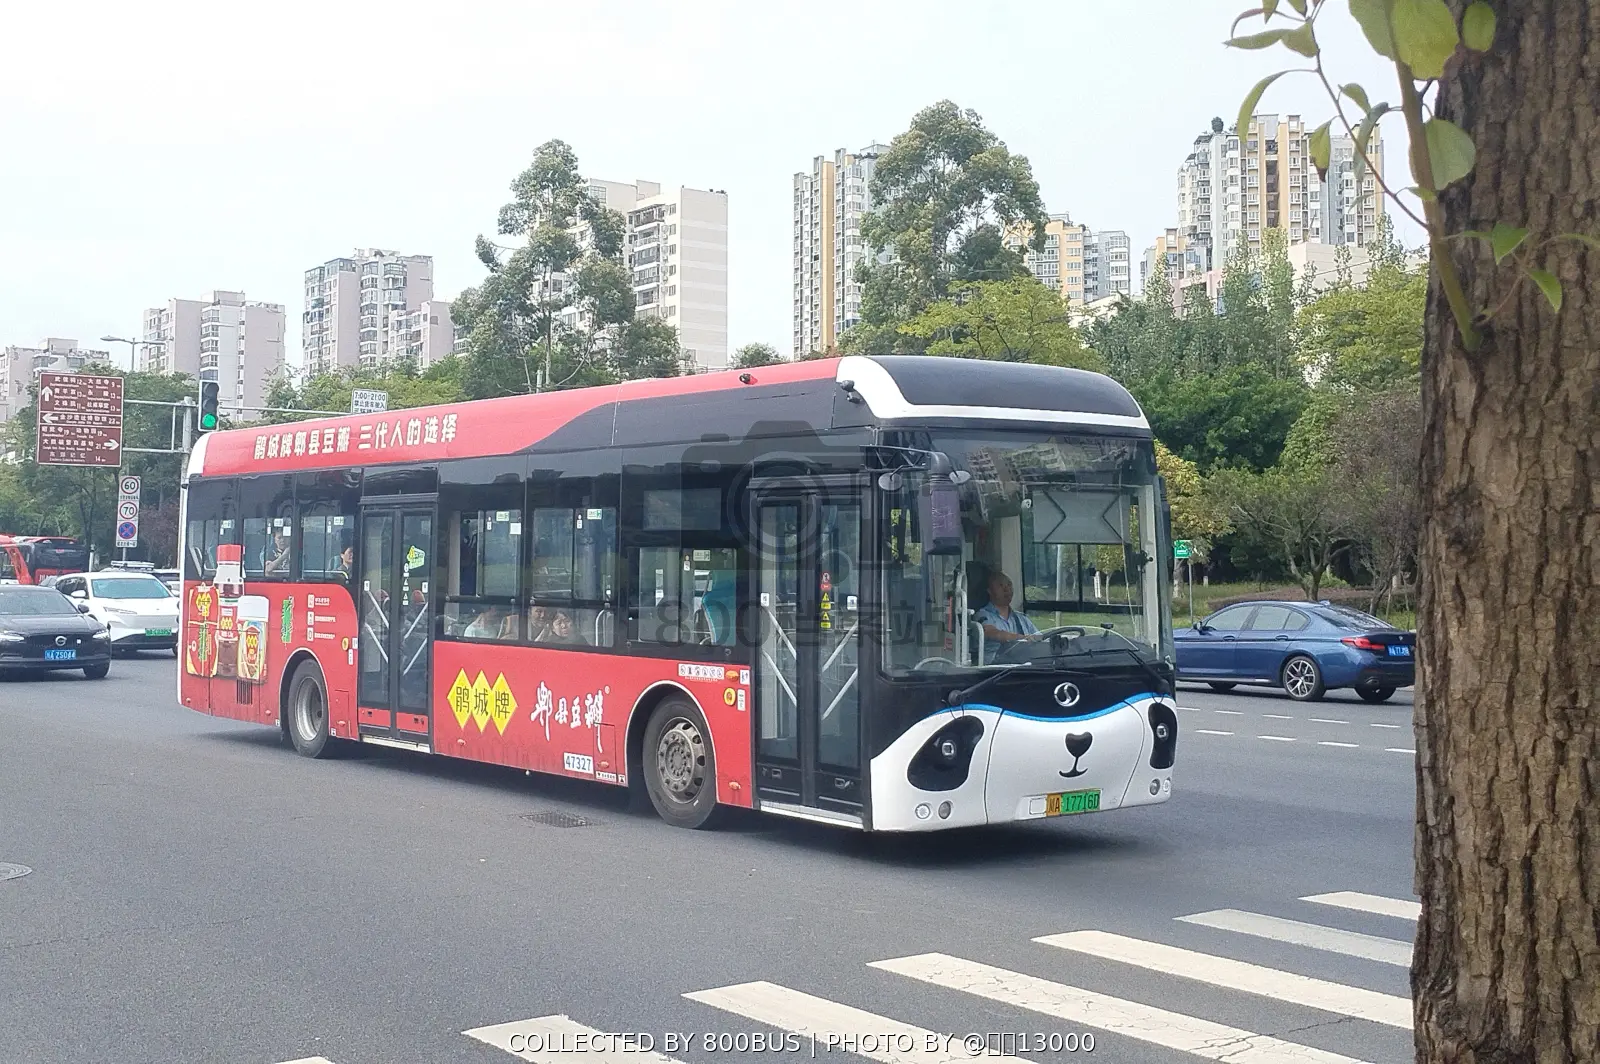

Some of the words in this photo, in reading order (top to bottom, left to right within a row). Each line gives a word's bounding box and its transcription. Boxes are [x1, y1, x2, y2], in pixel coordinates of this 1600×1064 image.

[253, 426, 350, 460] 鹃城牌郫县豆瓣
[358, 414, 458, 450] 三代人的选择
[123, 507, 134, 515] 70
[455, 687, 510, 718] 鹃城牌
[566, 756, 591, 771] 47327
